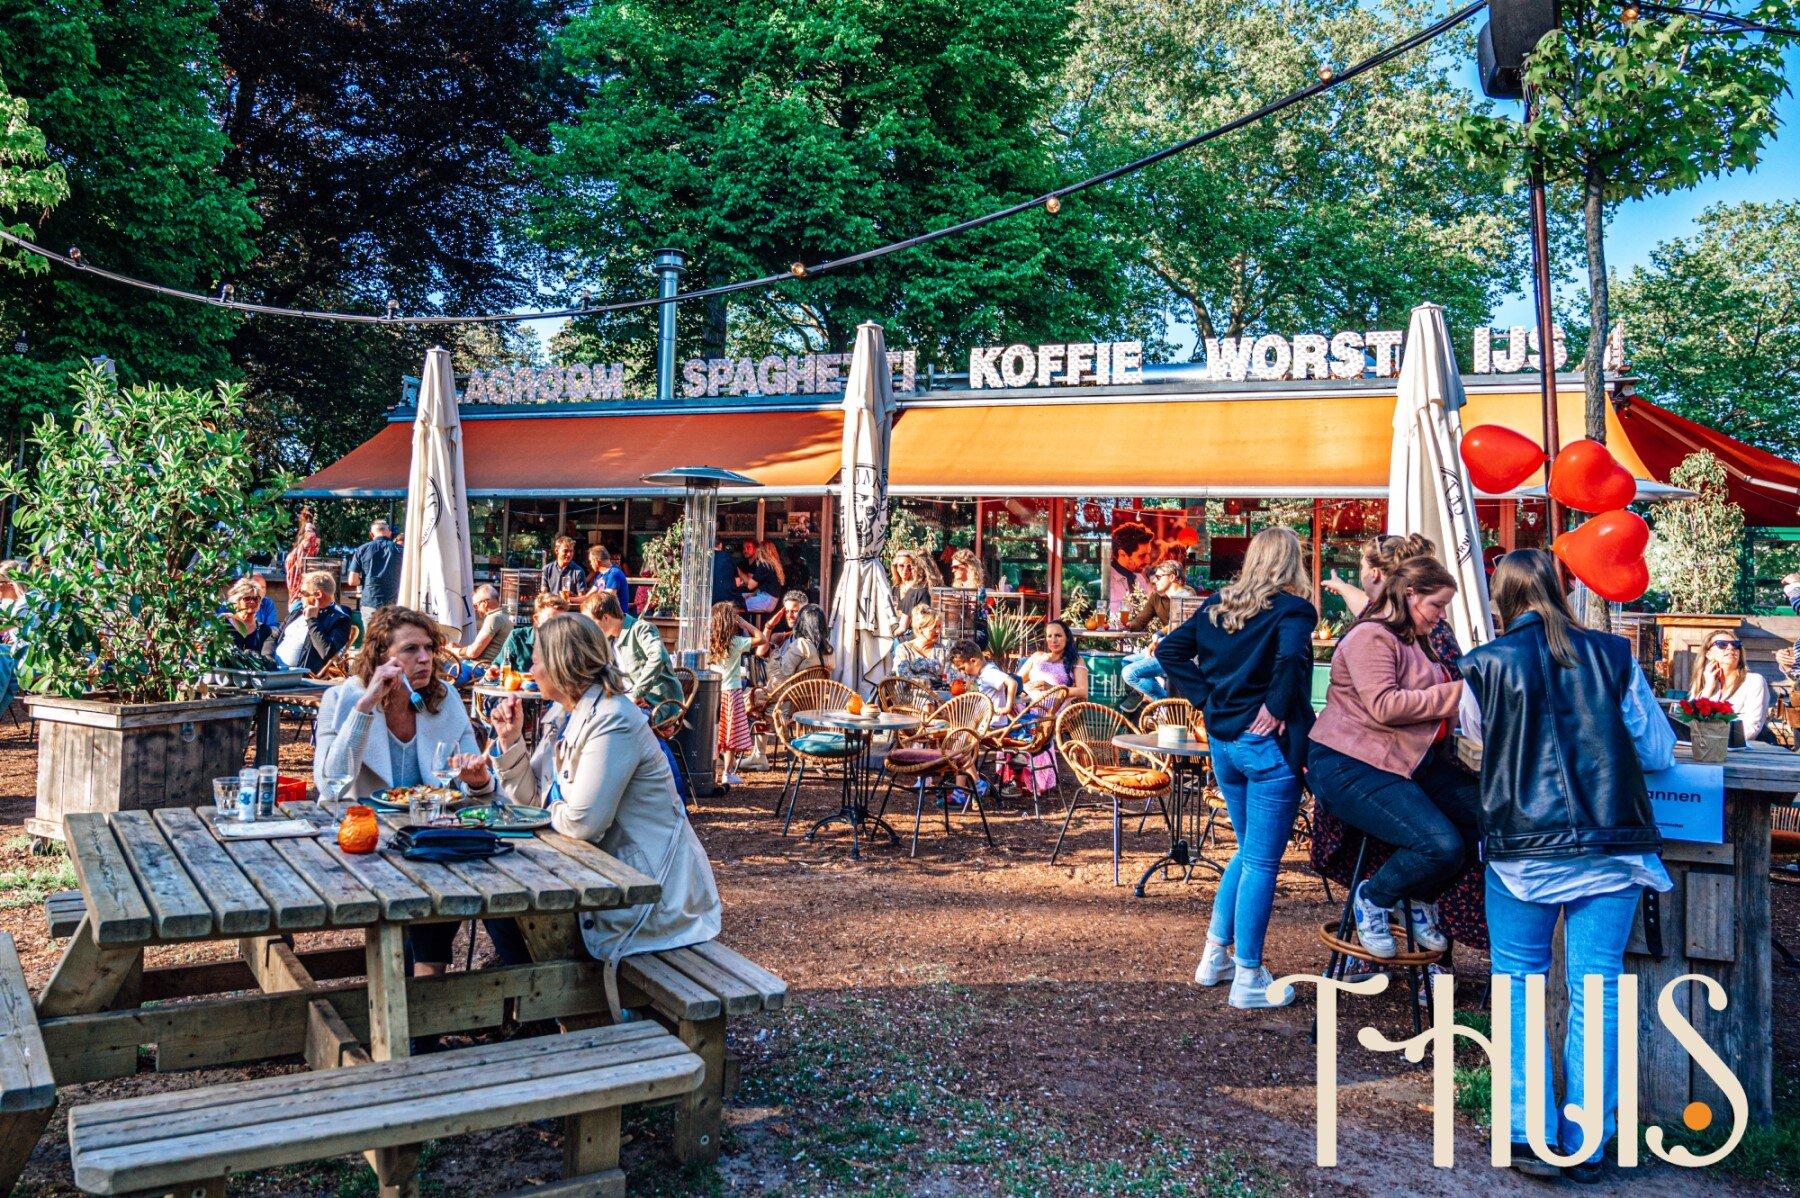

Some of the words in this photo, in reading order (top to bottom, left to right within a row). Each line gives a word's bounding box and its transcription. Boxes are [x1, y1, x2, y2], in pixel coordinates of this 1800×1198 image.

[456, 362, 624, 404] AGROOM
[683, 350, 916, 398] SPAGHEI
[969, 341, 1142, 389] KOFFIE
[1205, 331, 1403, 381] WORST
[1474, 323, 1568, 373] IJS
